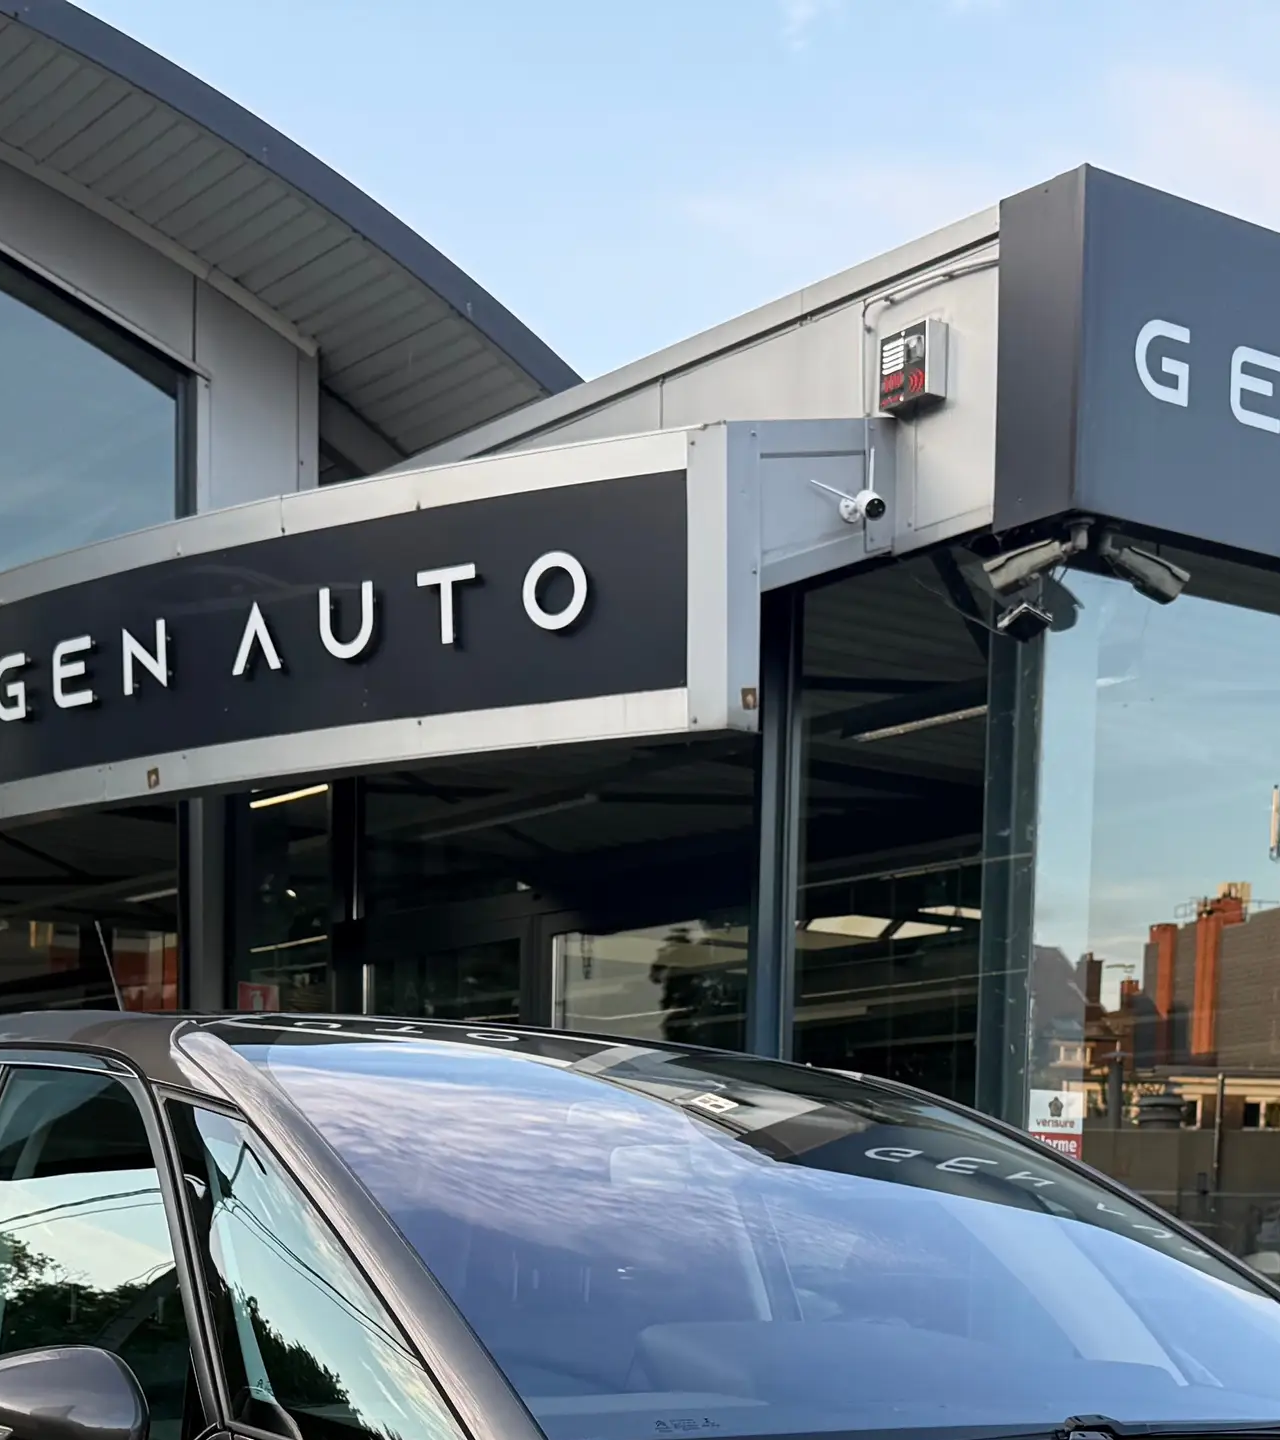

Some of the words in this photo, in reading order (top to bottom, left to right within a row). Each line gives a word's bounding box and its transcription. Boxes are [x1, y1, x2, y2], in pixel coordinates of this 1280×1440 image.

[232, 550, 589, 676] AUTO
[1035, 1118, 1075, 1129] verisure
[1034, 1133, 1077, 1153] larme
